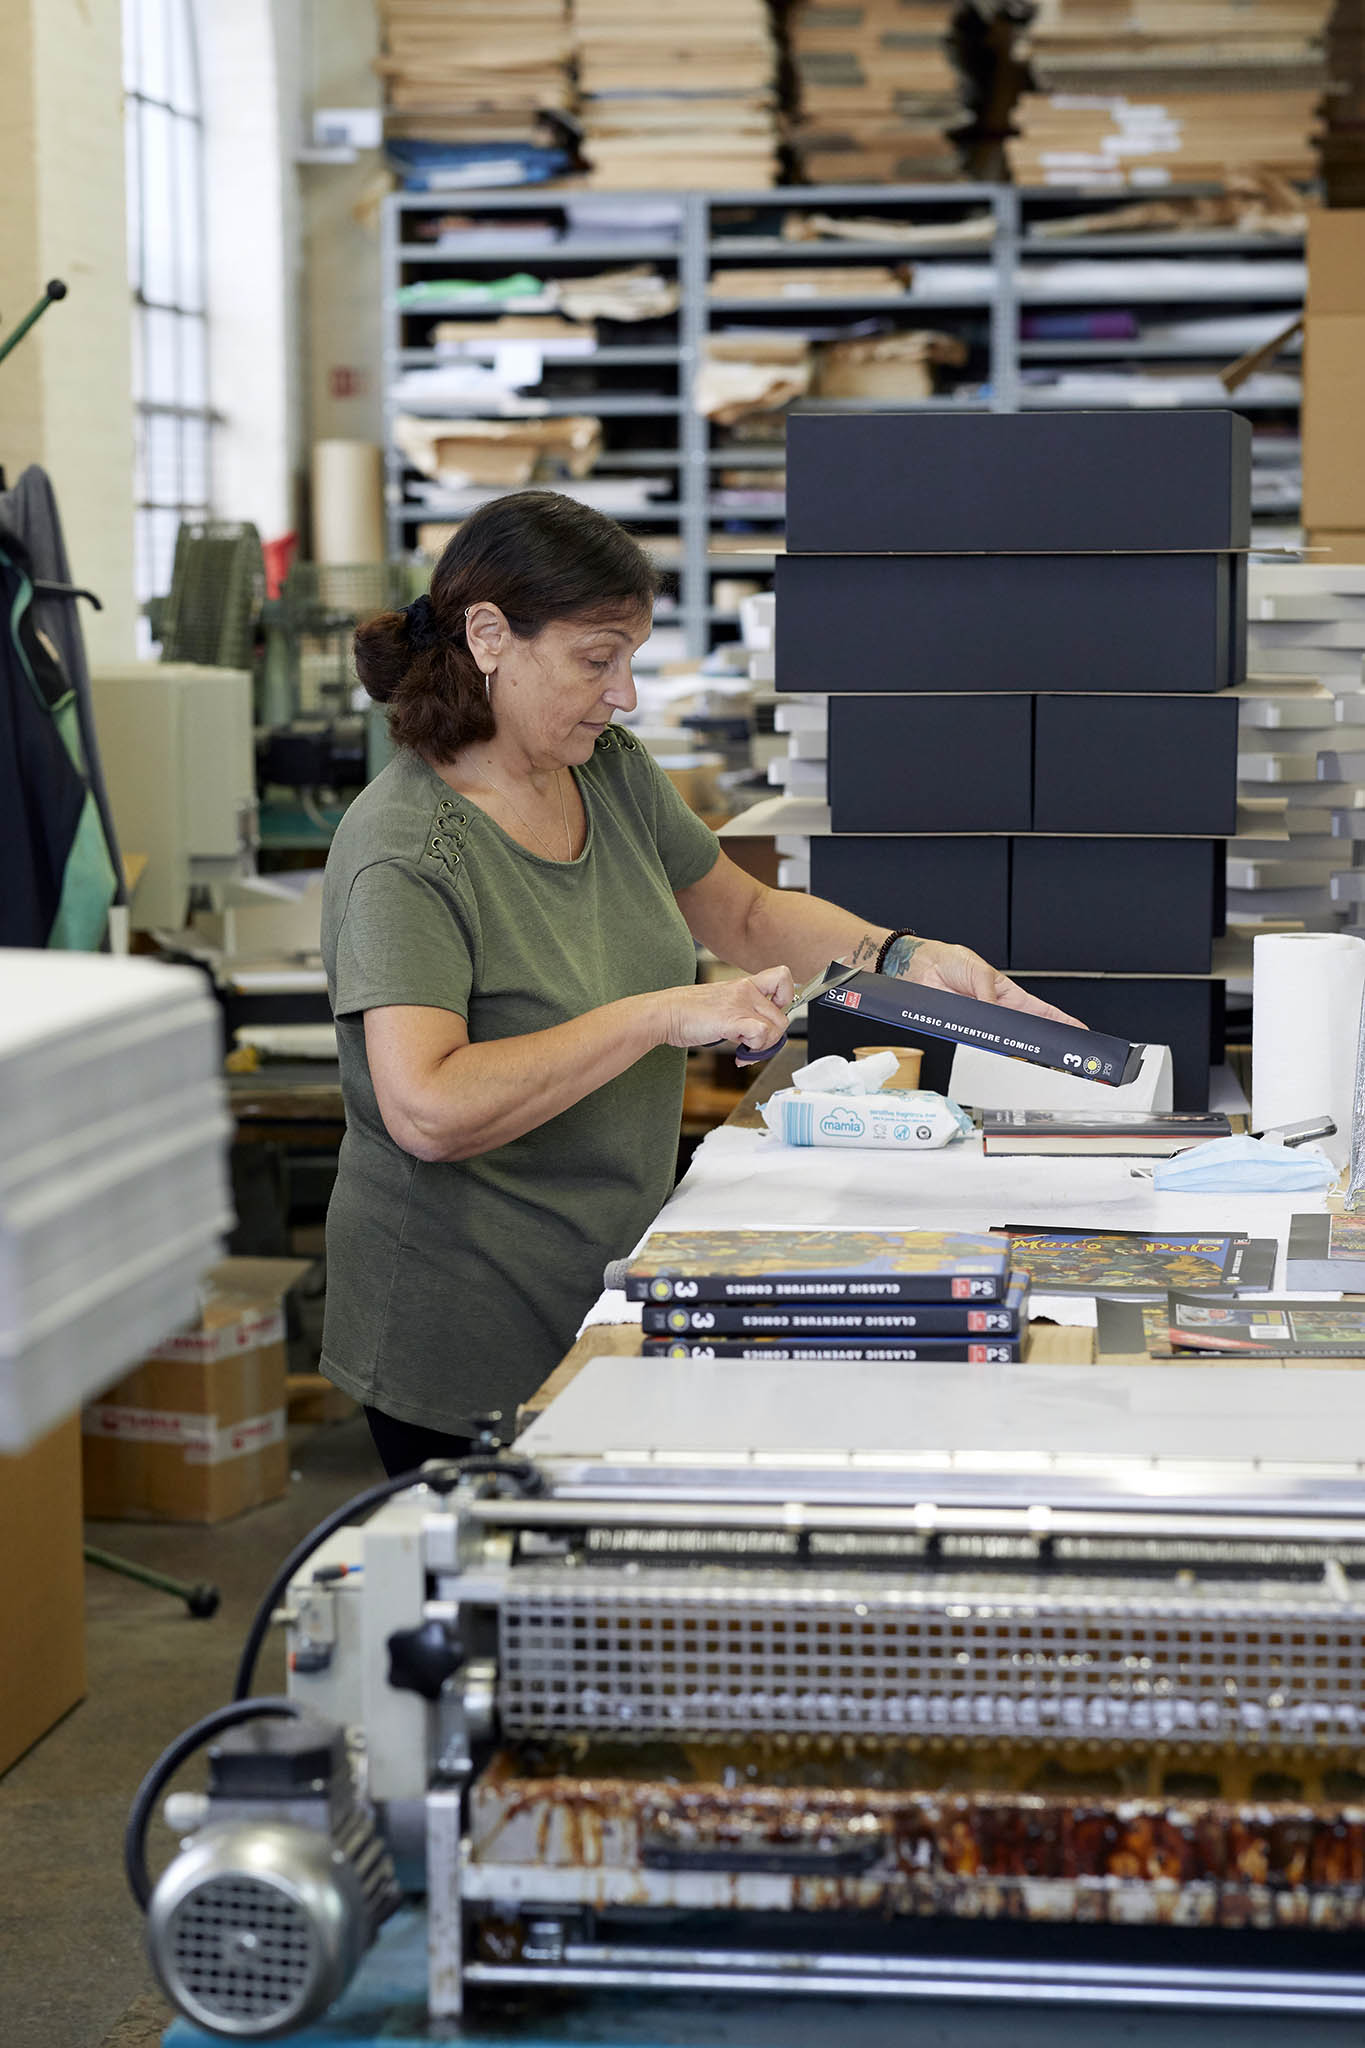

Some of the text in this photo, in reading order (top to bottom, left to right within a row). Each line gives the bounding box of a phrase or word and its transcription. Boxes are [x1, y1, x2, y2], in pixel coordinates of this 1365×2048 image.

[828, 988, 846, 1002] PS
[901, 1010, 1041, 1054] CLASSIC ADVENTURE COMICS
[1063, 1053, 1082, 1068] 3
[823, 1117, 860, 1132] mamia
[674, 1281, 698, 1298] 3
[726, 1284, 900, 1294] CLASSIC ADVENTURE COMICS
[970, 1281, 994, 1296] PS
[691, 1312, 715, 1329] 3
[742, 1316, 916, 1326] CLASSIC ADVENTURE COMICS
[986, 1313, 1009, 1329] PS
[742, 1350, 916, 1360] CLASSIC ADVENTURE COMICS
[986, 1347, 1009, 1362] PS
